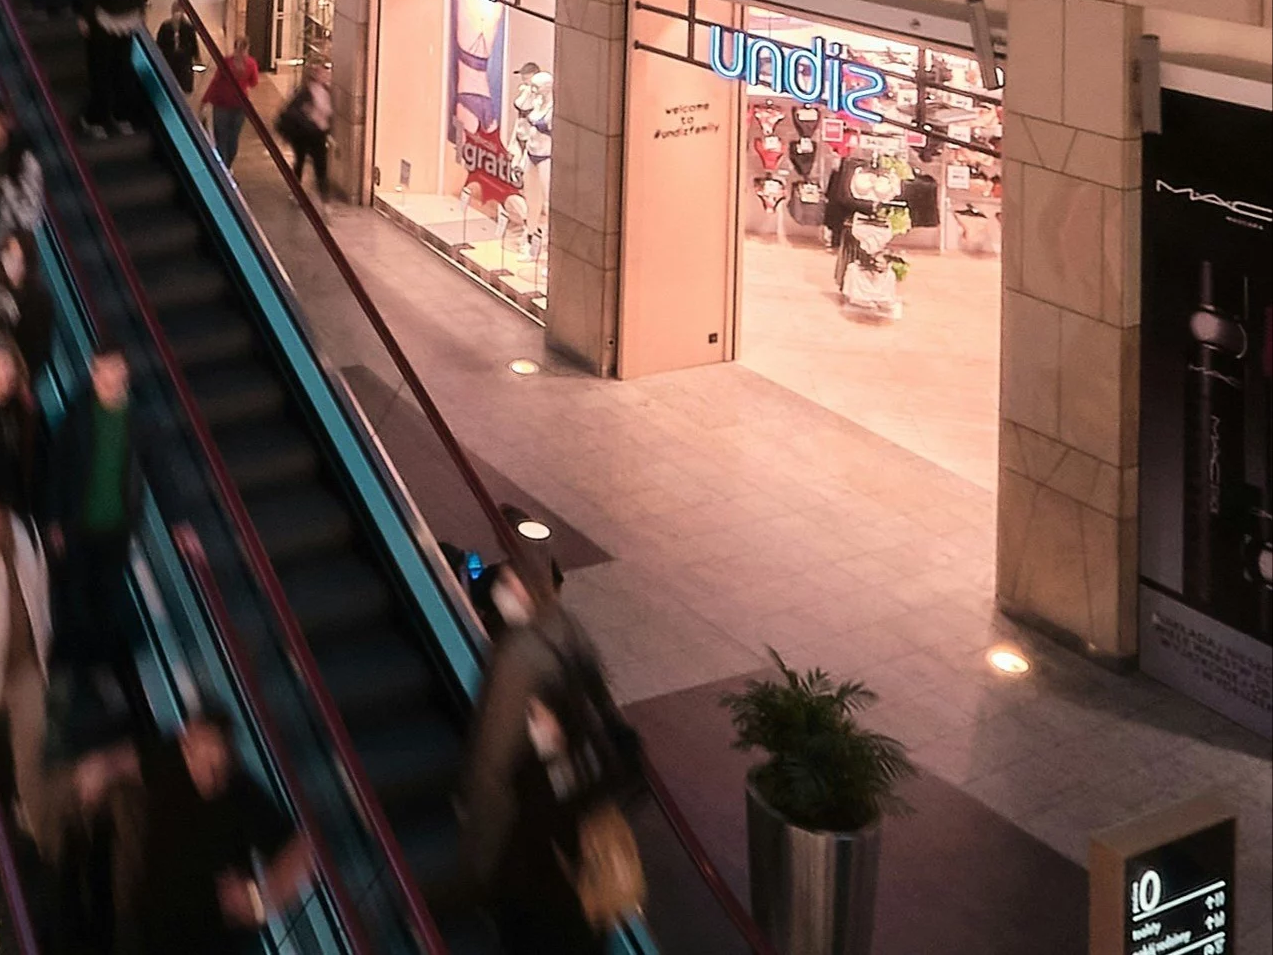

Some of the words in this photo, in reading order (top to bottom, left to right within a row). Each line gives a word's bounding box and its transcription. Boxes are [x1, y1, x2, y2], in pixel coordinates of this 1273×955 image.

[710, 25, 885, 124] undiz
[665, 103, 710, 115] welcome
[681, 116, 694, 125] to
[462, 142, 525, 189] gratis
